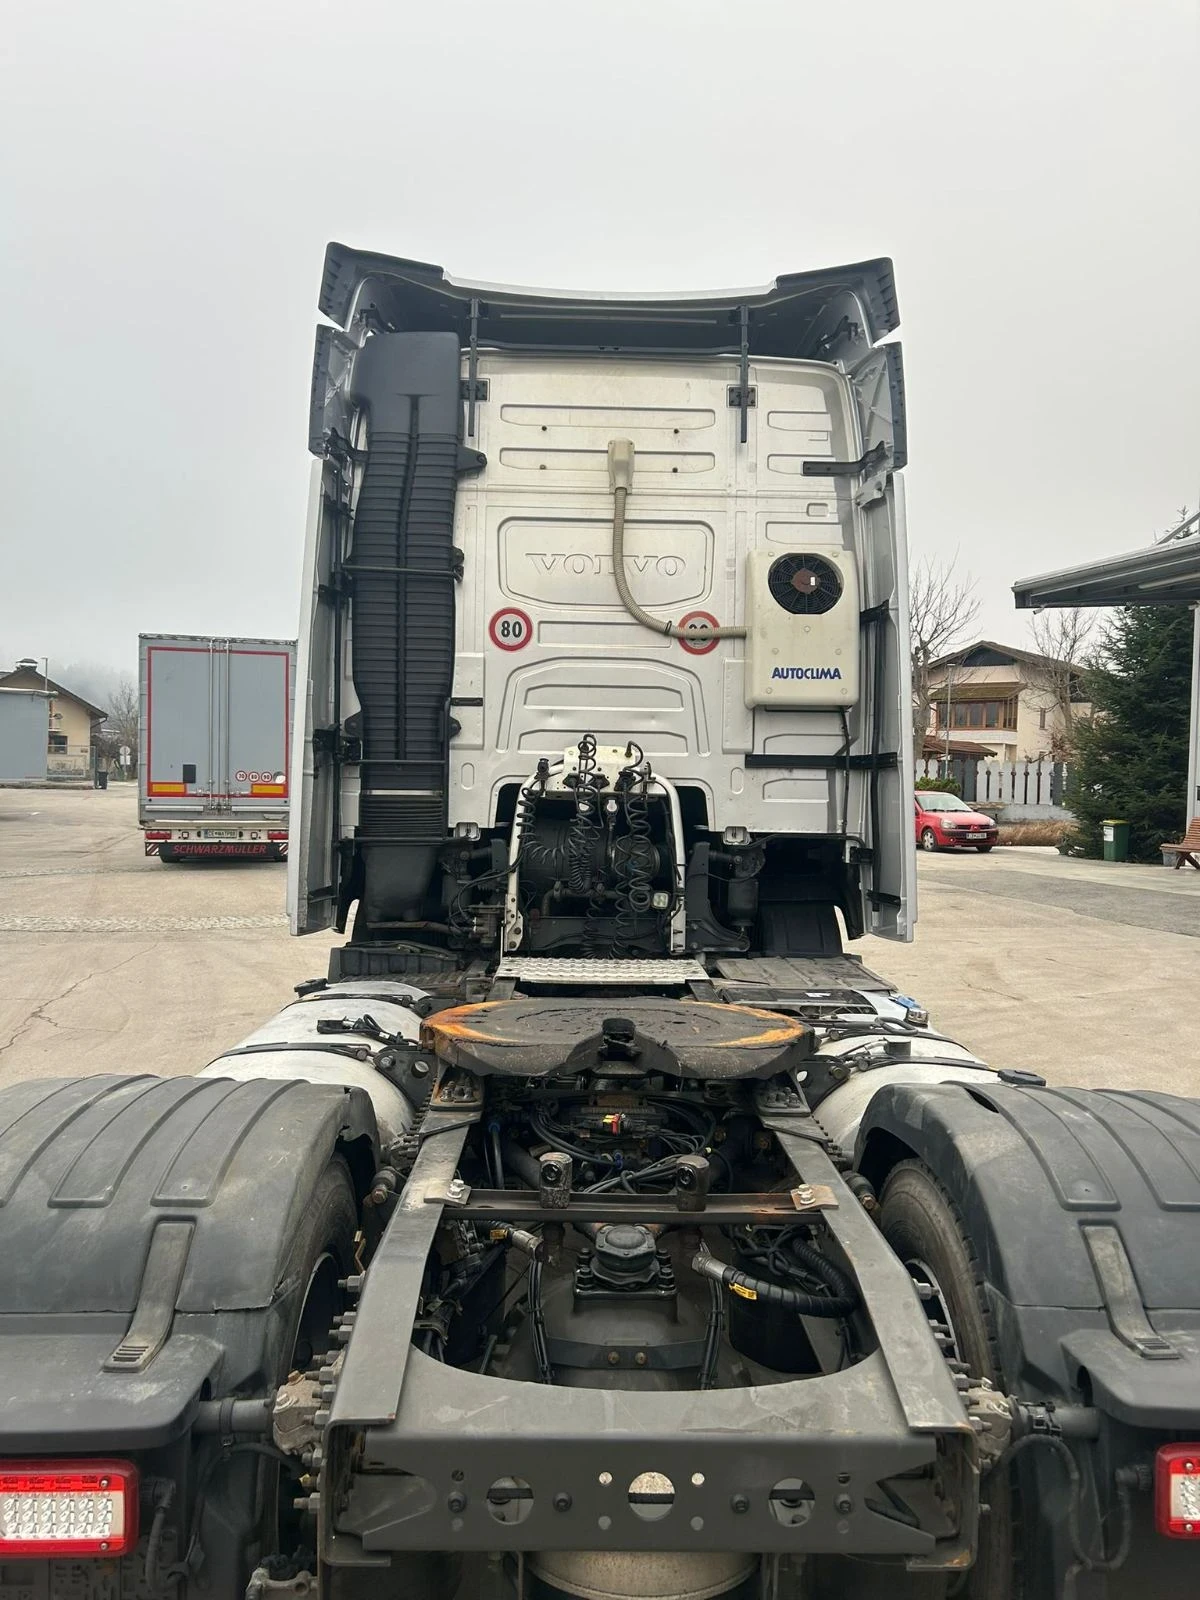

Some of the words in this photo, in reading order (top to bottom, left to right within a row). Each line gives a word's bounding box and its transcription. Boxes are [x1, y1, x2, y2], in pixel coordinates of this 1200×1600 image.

[525, 553, 687, 576] VOLVO
[501, 620, 522, 638] 80
[771, 666, 842, 680] AUTOCLIMA
